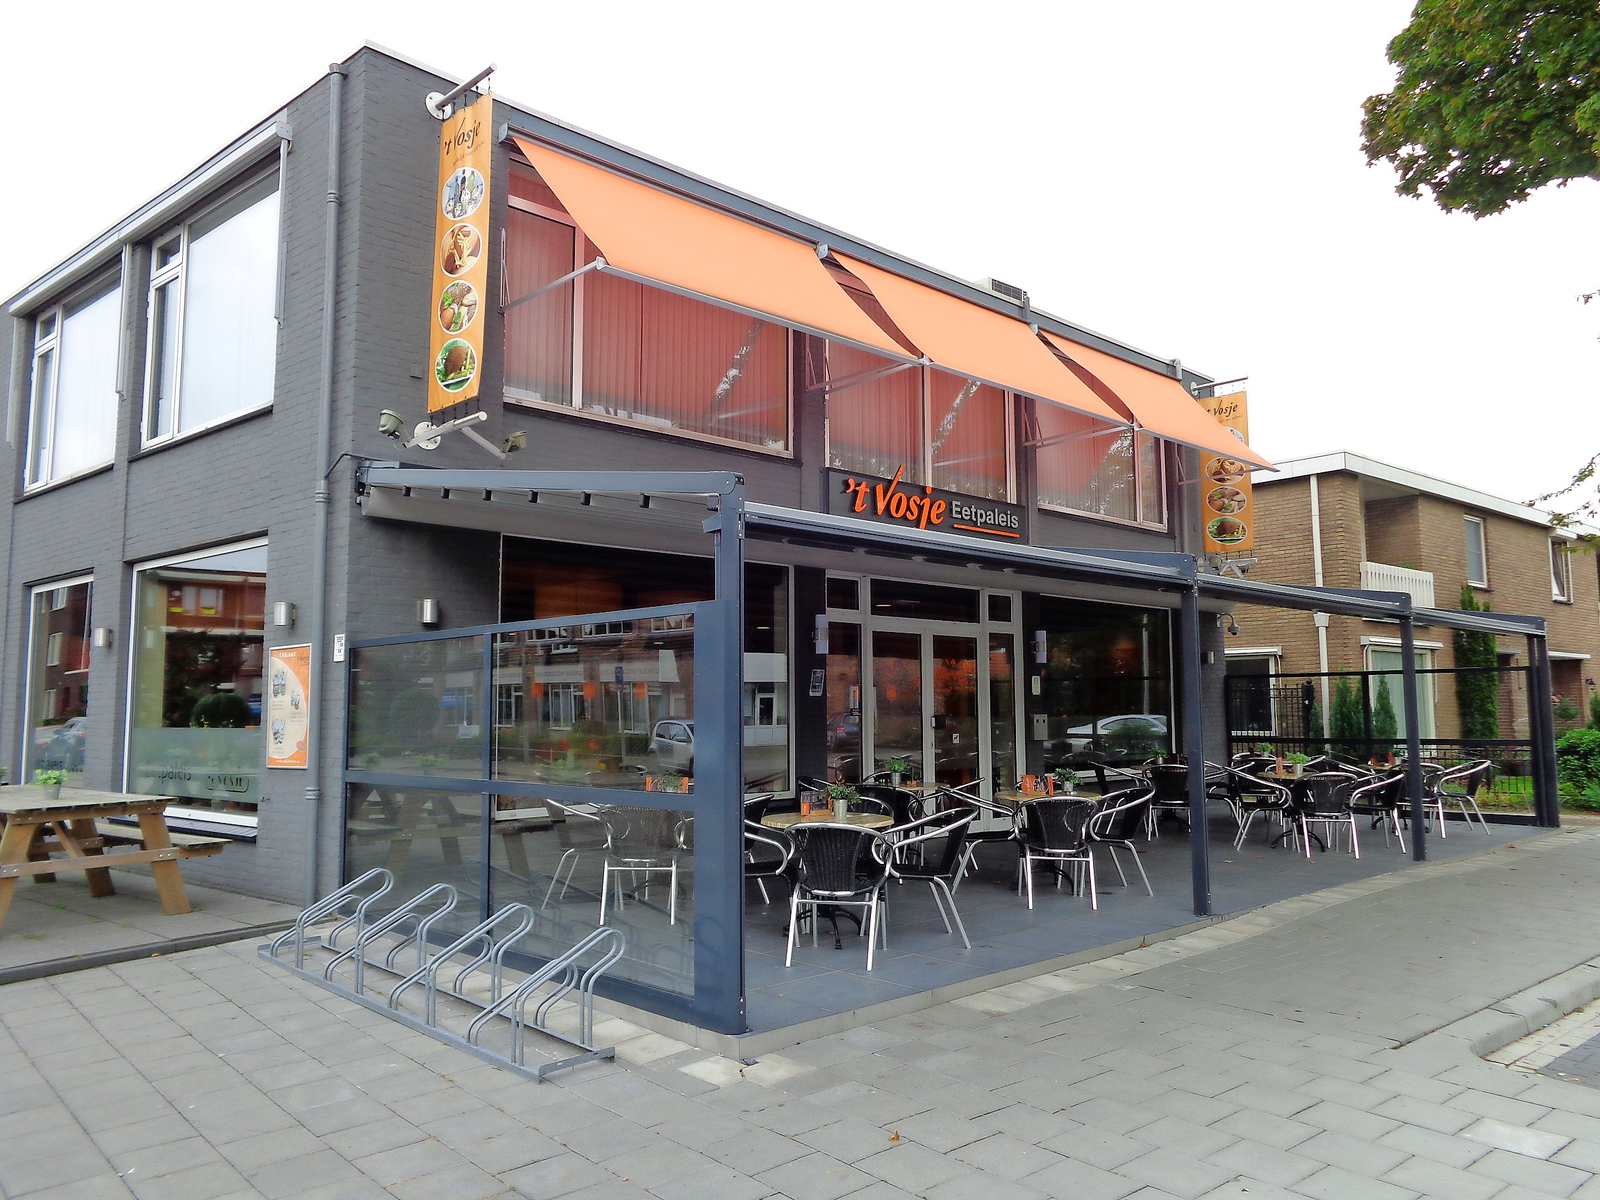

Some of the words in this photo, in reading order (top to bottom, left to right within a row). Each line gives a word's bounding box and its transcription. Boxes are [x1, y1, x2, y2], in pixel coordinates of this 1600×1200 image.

[453, 117, 481, 150] Vosje
[1213, 400, 1238, 418] Vosje
[846, 477, 870, 513] 't
[875, 464, 947, 530] Vosje
[951, 500, 1019, 529] Eetpaleis
